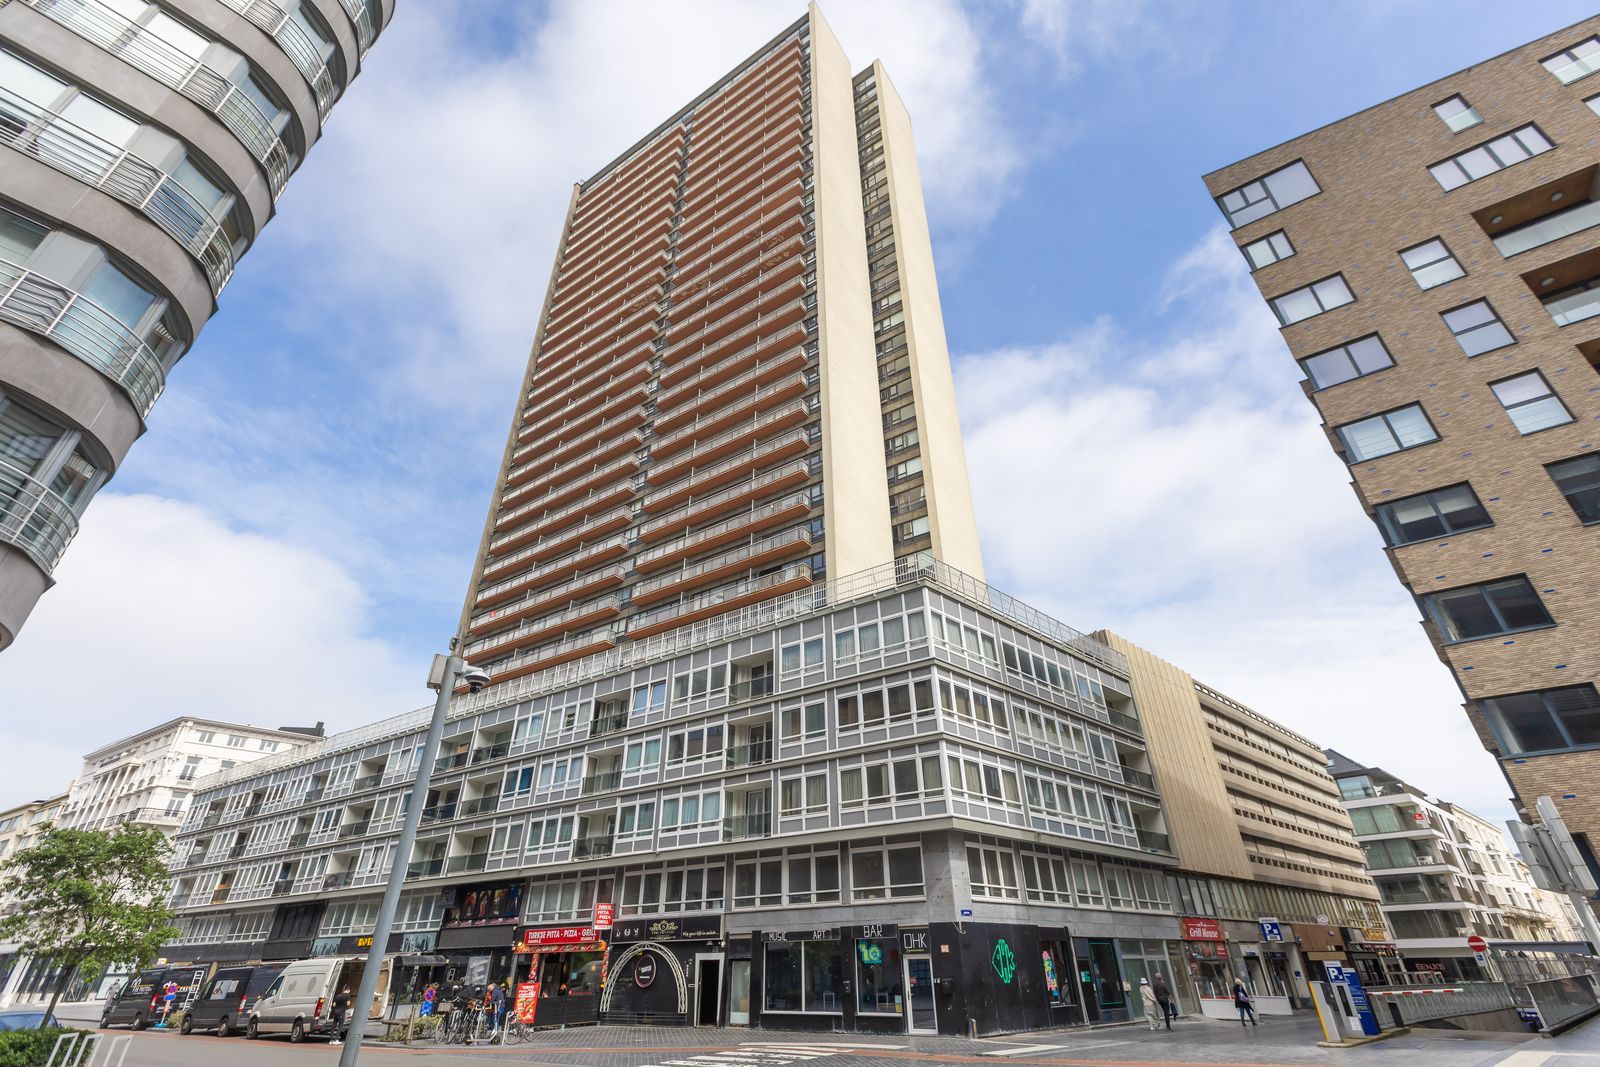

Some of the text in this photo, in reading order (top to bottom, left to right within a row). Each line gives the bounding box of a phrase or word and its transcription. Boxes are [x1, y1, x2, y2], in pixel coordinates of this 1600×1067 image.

[864, 925, 882, 938] BAR
[1190, 928, 1218, 938] Grill House
[1263, 924, 1272, 933] P
[528, 931, 546, 939] TURKSE
[769, 931, 787, 941] MUSIC
[813, 930, 826, 940] ART
[904, 933, 927, 948] OHK
[1328, 968, 1338, 979] P
